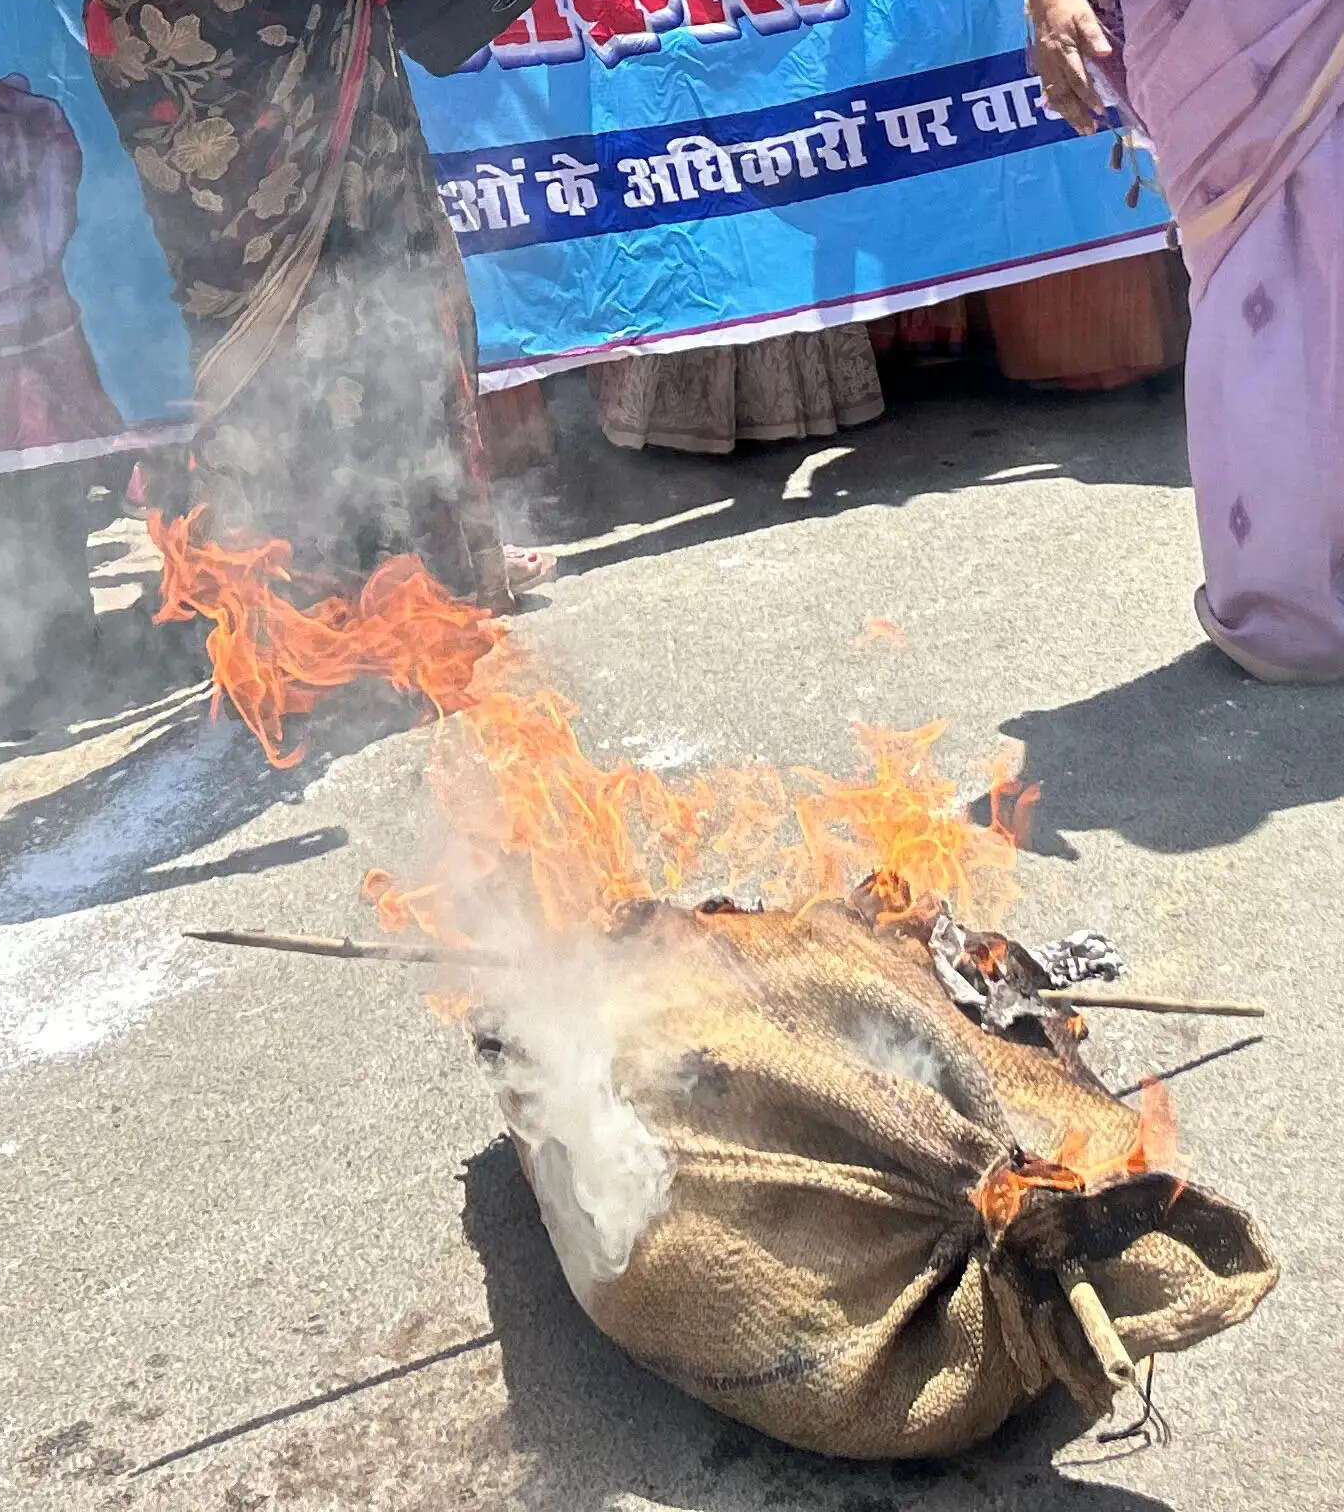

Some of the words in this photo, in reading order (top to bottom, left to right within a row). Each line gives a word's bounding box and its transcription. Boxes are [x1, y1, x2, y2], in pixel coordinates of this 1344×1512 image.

[535, 153, 599, 218] के
[616, 100, 870, 213] अधिकारों
[875, 93, 958, 156] पर
